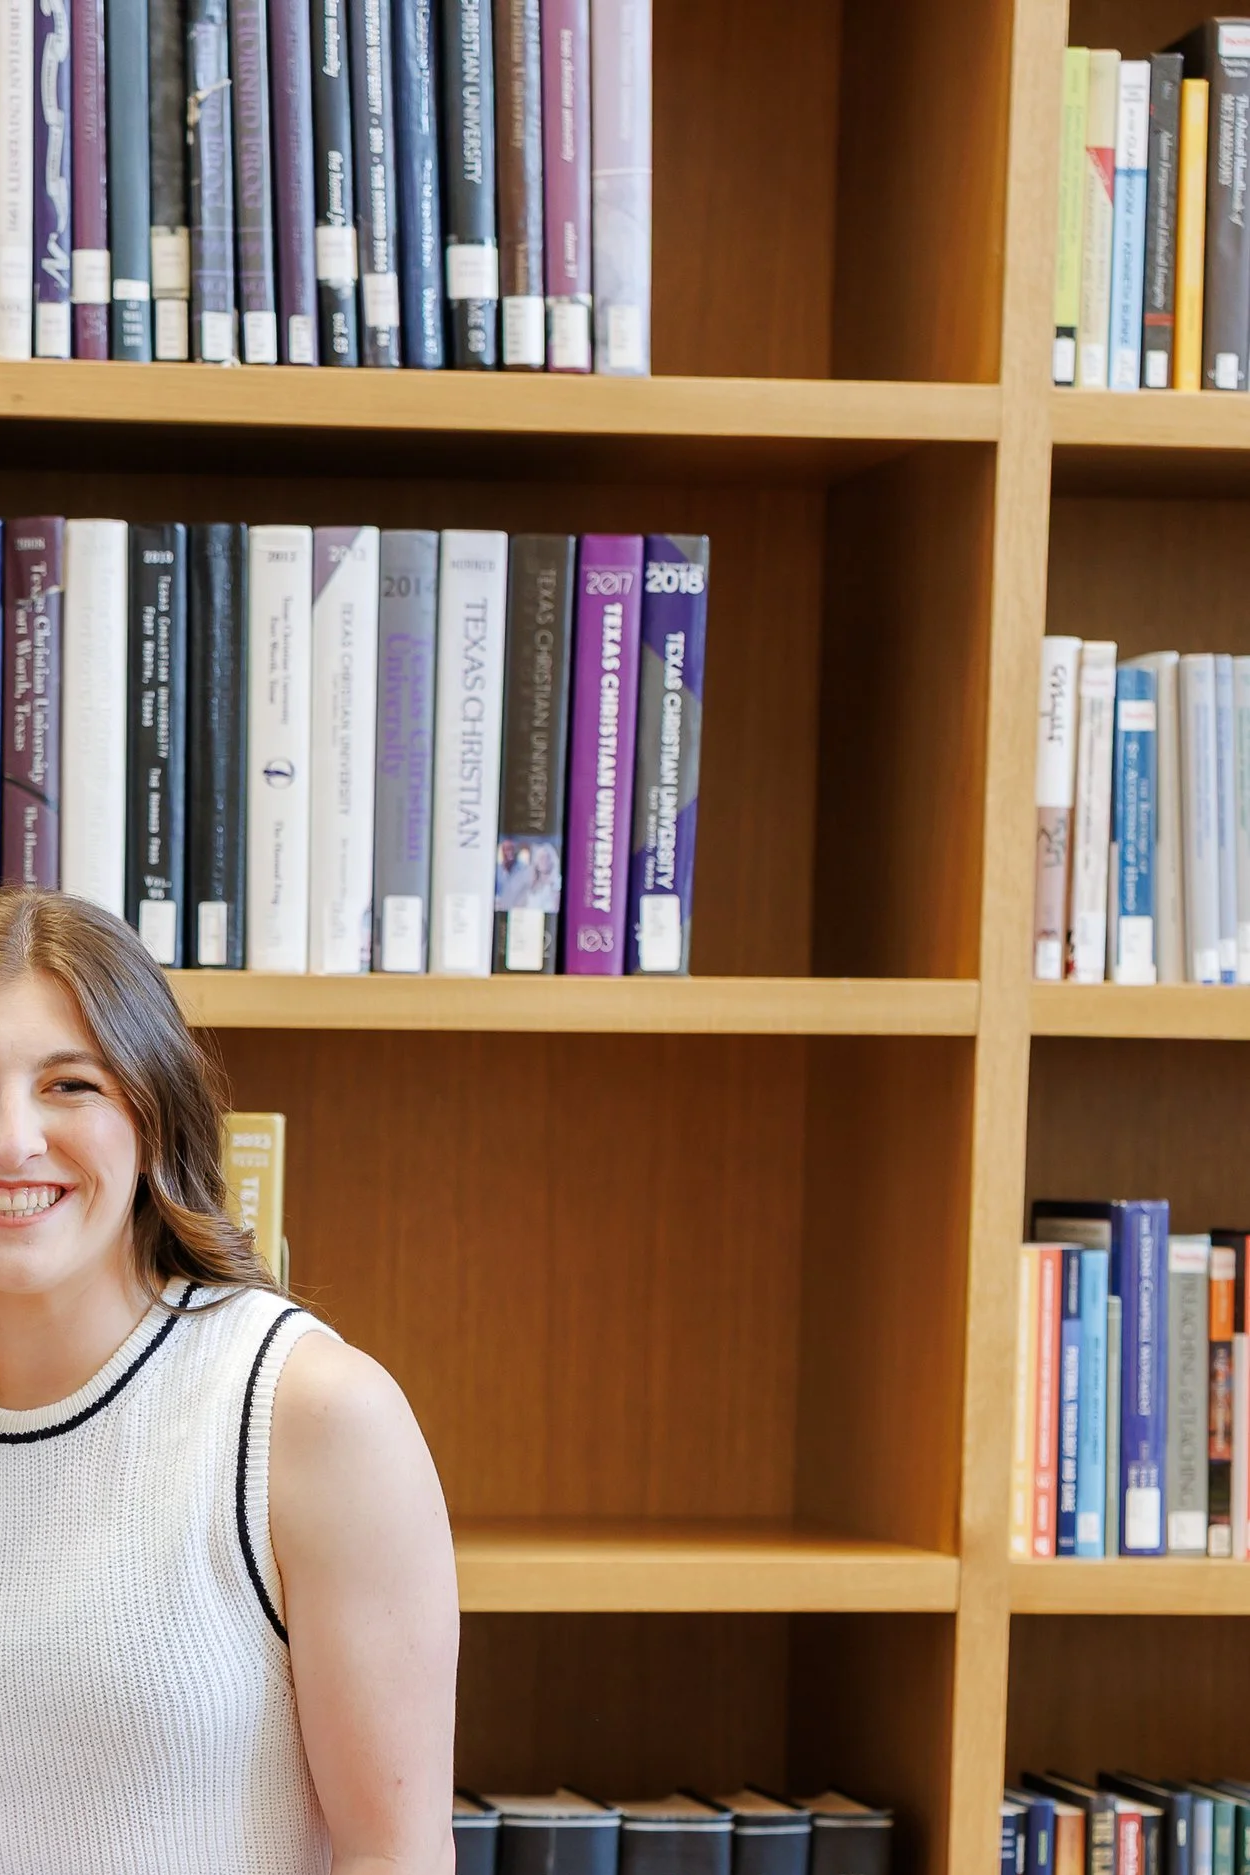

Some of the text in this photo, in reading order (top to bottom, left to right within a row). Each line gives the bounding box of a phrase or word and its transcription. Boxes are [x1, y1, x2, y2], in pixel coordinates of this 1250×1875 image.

[462, 86, 483, 184] UNIVERSITY
[33, 614, 52, 695] Christian
[381, 632, 414, 780] University
[457, 597, 490, 850] TEXAS CHRISTIAN
[527, 568, 557, 832] TEXAS CHRISTIAN UNIVERSITY
[14, 704, 31, 752] Texas
[29, 698, 50, 786] University
[405, 727, 432, 862] Christian
[590, 603, 625, 913] TEXAS CHRISTIAN UNIVERSITY
[653, 631, 686, 891] TEXAS CHRISTIAN UNIVERSITY
